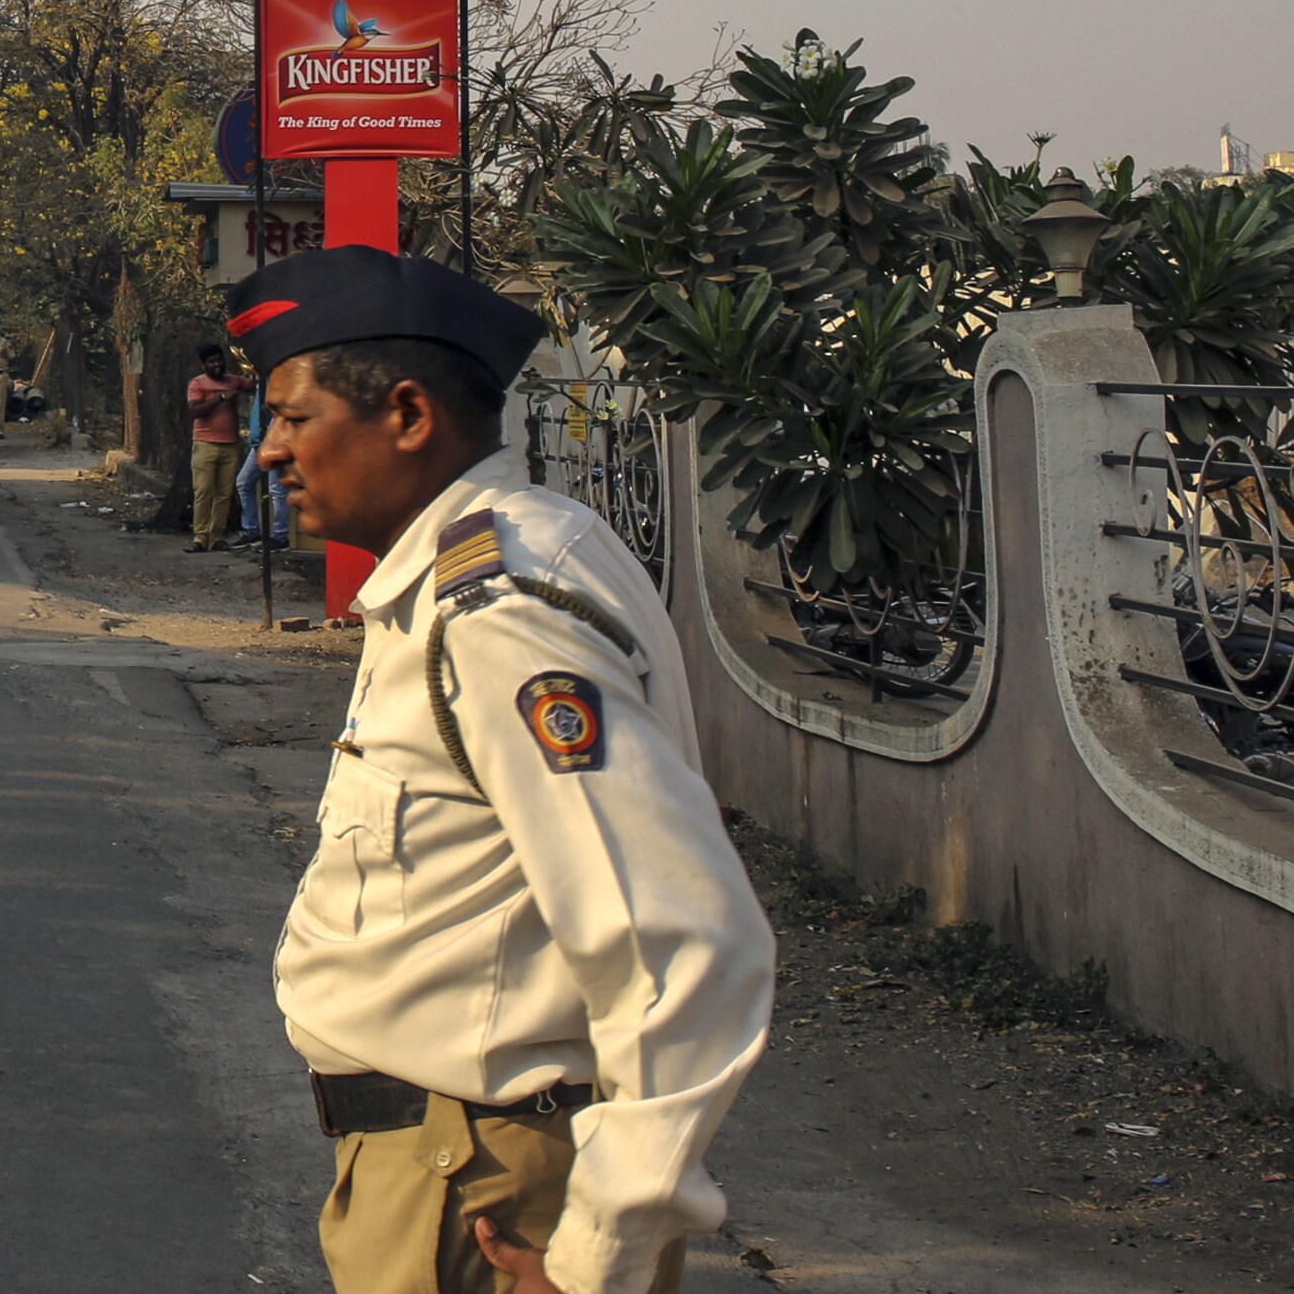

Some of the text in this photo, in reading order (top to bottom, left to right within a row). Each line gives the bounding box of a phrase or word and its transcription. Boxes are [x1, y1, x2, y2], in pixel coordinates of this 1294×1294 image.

[287, 54, 436, 90] KINGFISHER
[278, 116, 442, 131] The King of Good Times
